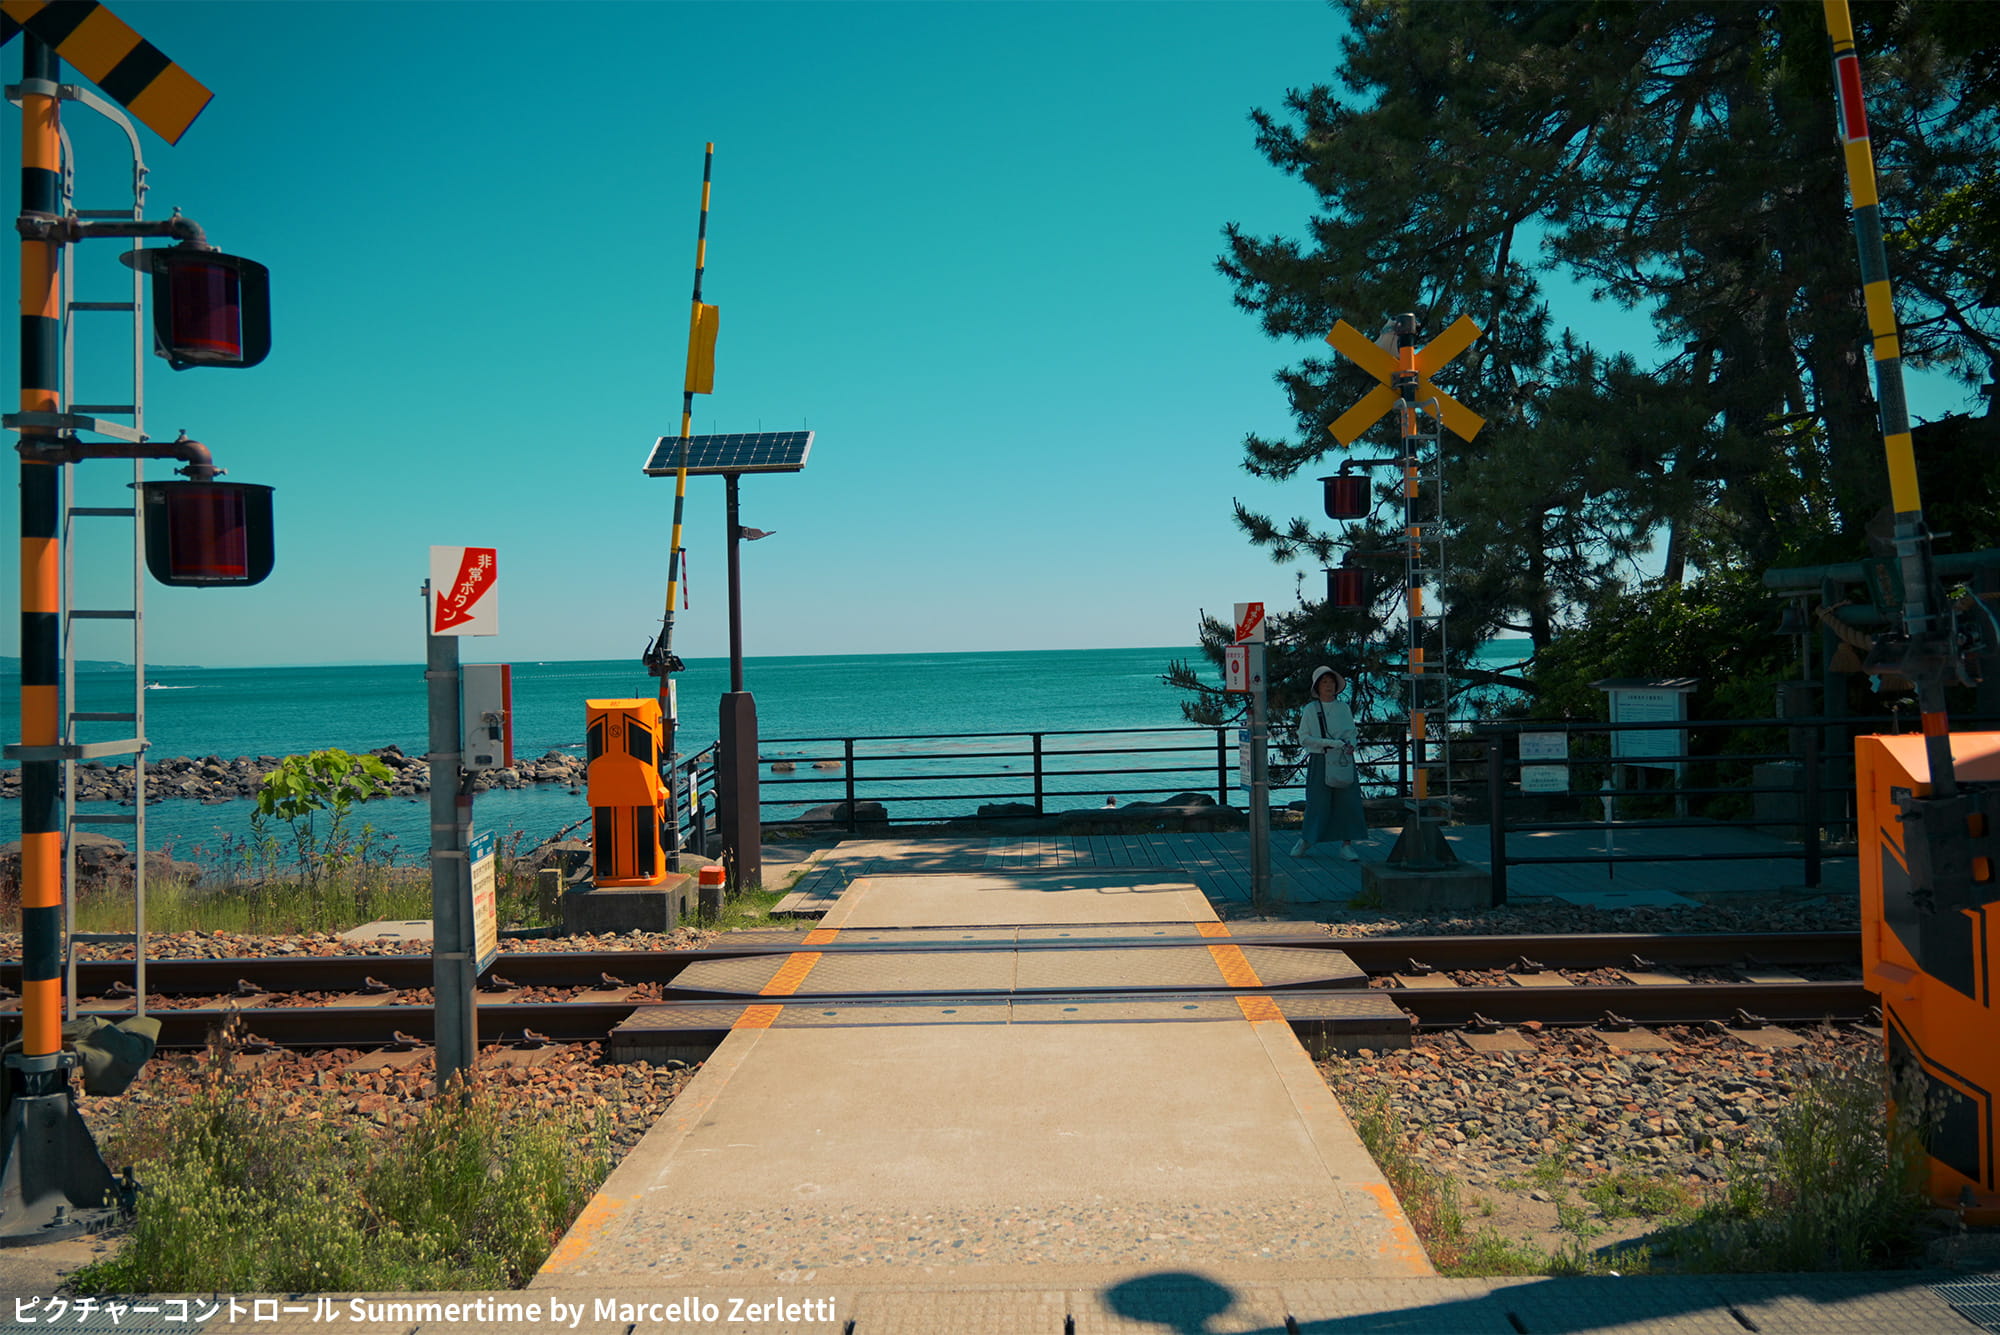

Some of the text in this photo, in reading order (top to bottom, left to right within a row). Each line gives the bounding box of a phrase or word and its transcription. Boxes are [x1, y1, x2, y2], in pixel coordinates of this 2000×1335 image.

[443, 554, 492, 621] 非常ボタン
